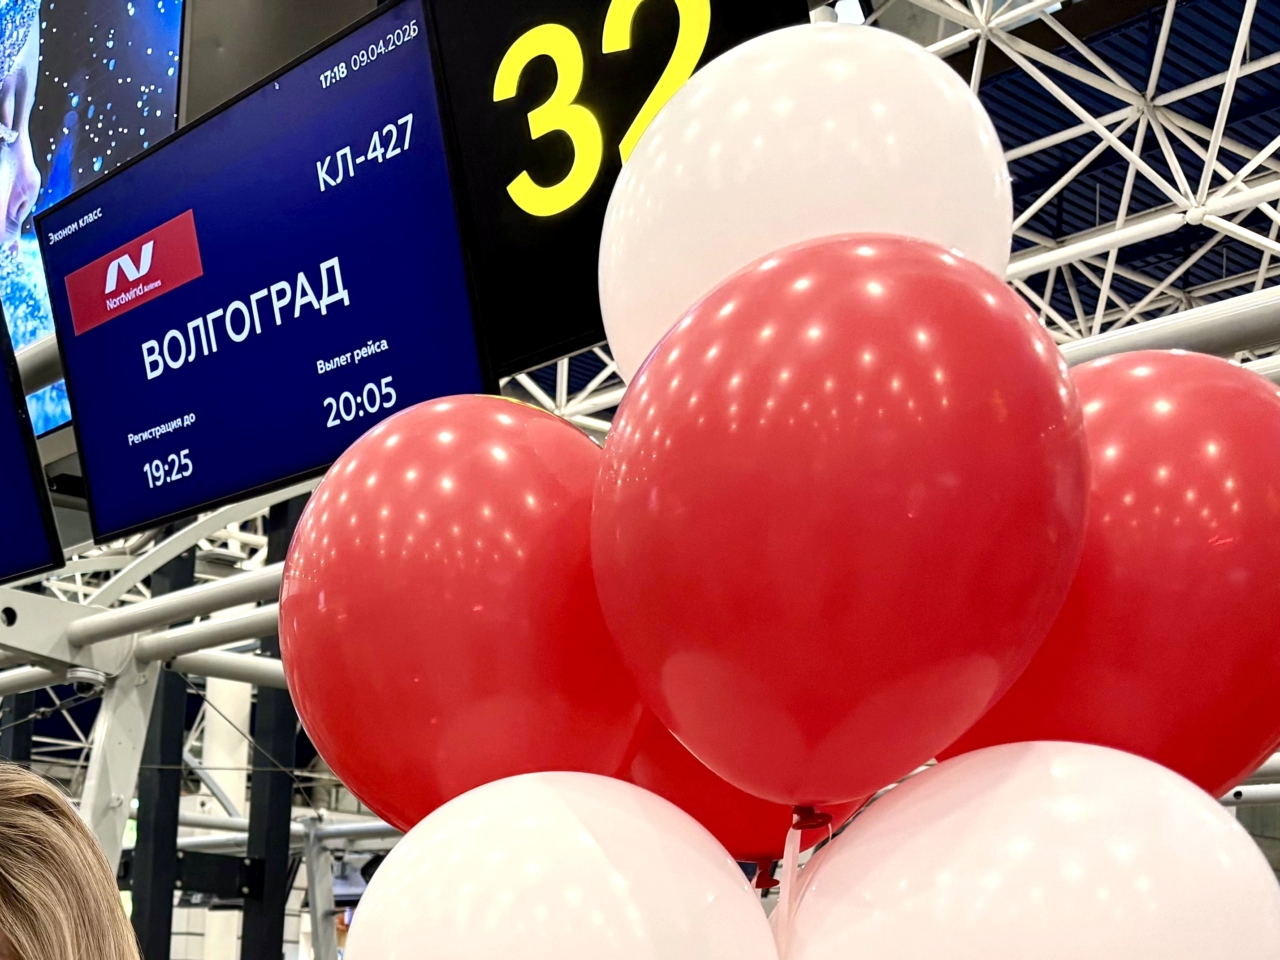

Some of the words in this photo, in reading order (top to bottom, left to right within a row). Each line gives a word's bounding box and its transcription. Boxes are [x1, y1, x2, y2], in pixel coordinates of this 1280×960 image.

[319, 62, 348, 89] 17:18
[493, 0, 711, 217] 32
[316, 112, 414, 192] КЛ-427
[48, 221, 79, 246] Эконом
[78, 207, 103, 228] класс
[106, 283, 144, 311] Nordwind
[141, 256, 350, 380] ВОЛГОГРАД
[316, 352, 352, 374] Вылет
[354, 338, 389, 364] рейса
[323, 375, 397, 428] 20:05
[127, 416, 183, 446] Регистрация
[183, 412, 196, 428] до
[143, 448, 194, 489] 19:25
